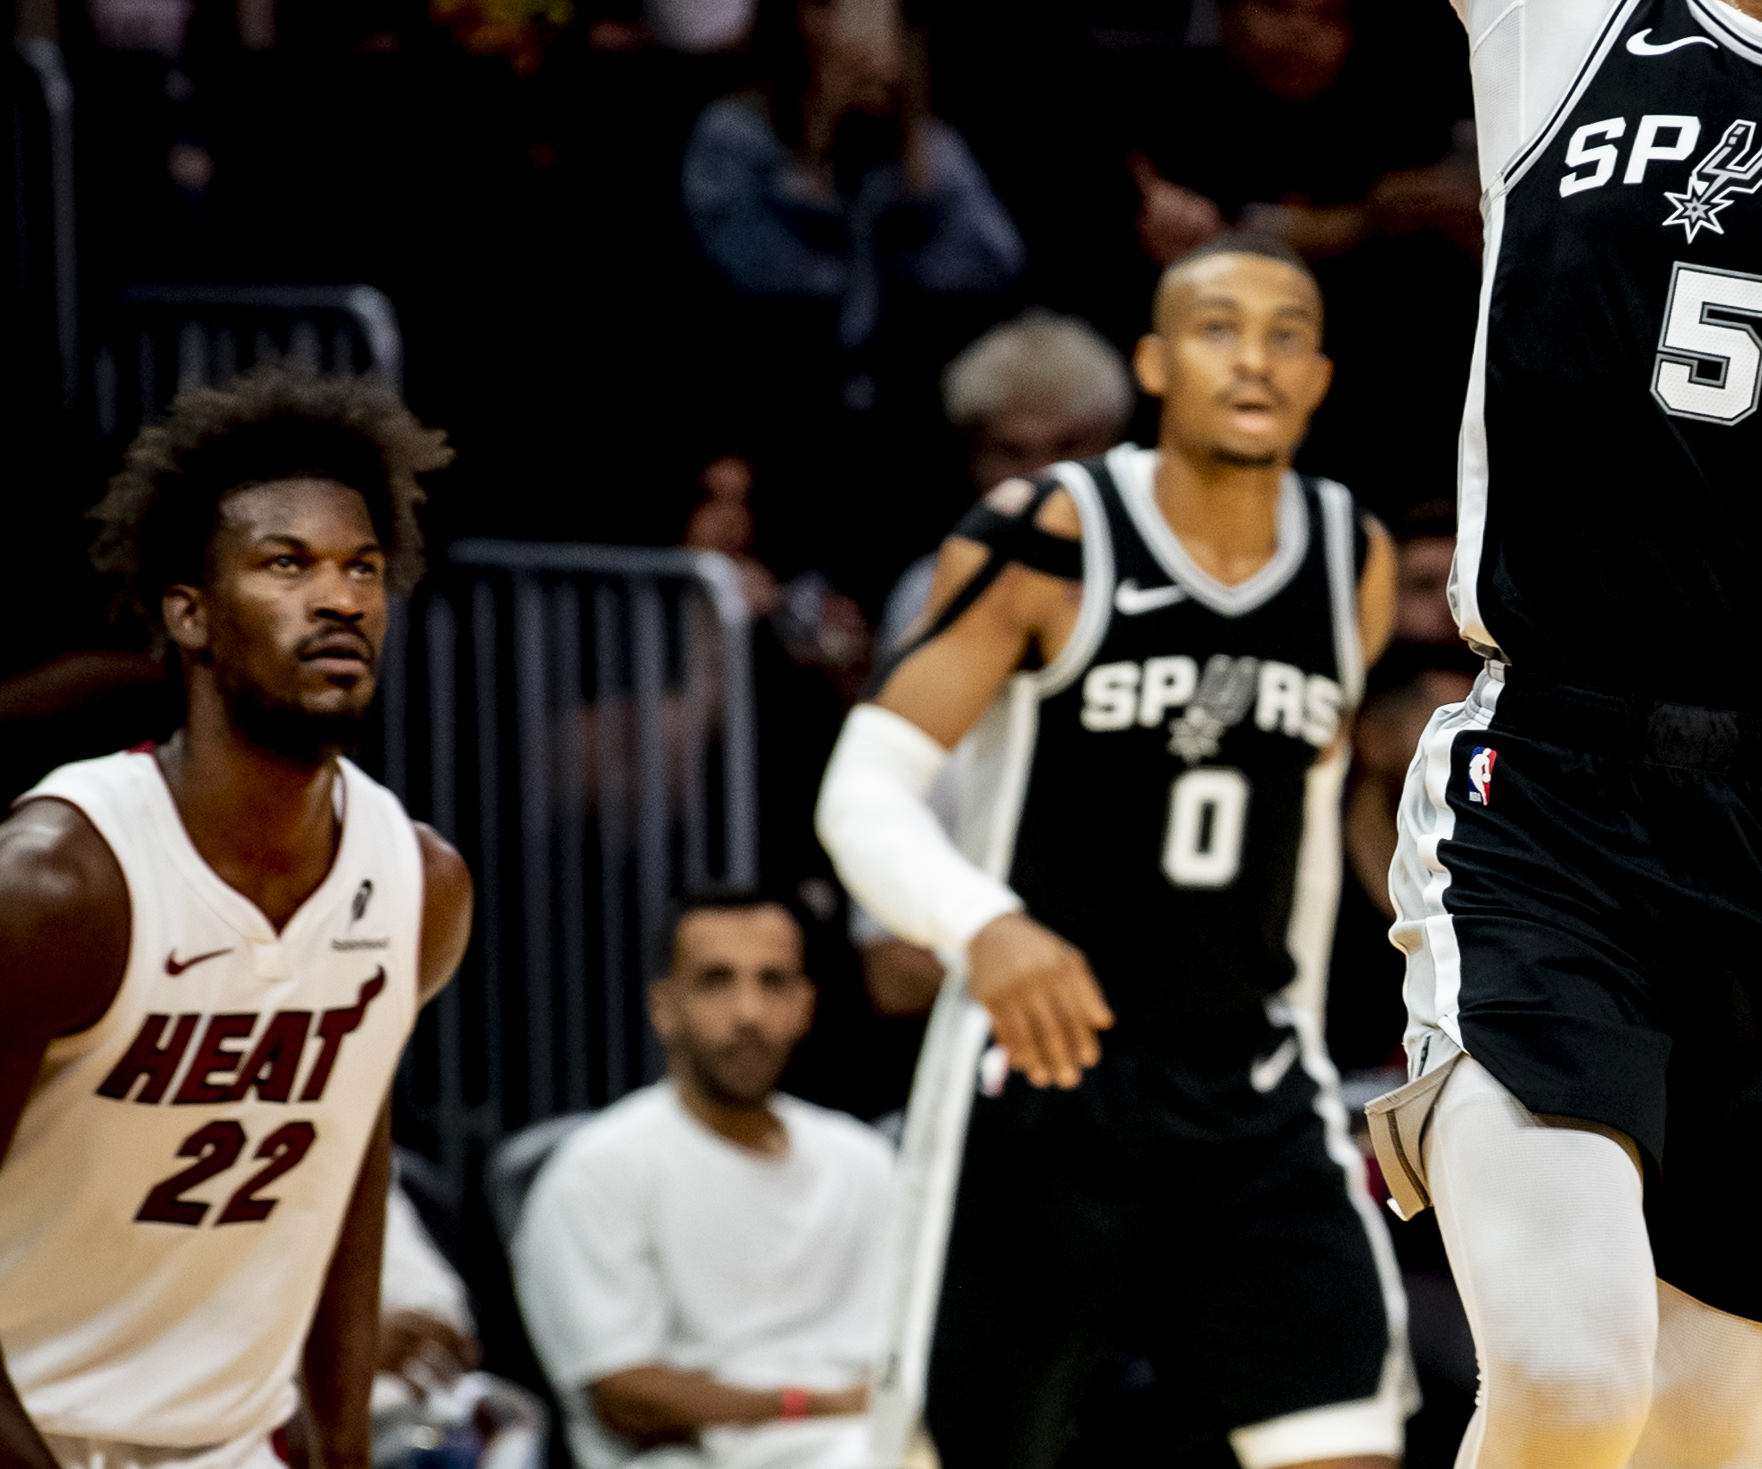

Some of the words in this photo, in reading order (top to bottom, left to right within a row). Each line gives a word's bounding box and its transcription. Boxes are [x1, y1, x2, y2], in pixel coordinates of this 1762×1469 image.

[1080, 653, 1346, 763] SPURS
[1160, 766, 1251, 888] 0
[95, 963, 387, 1106] HEAT
[132, 1119, 319, 1228] 22
